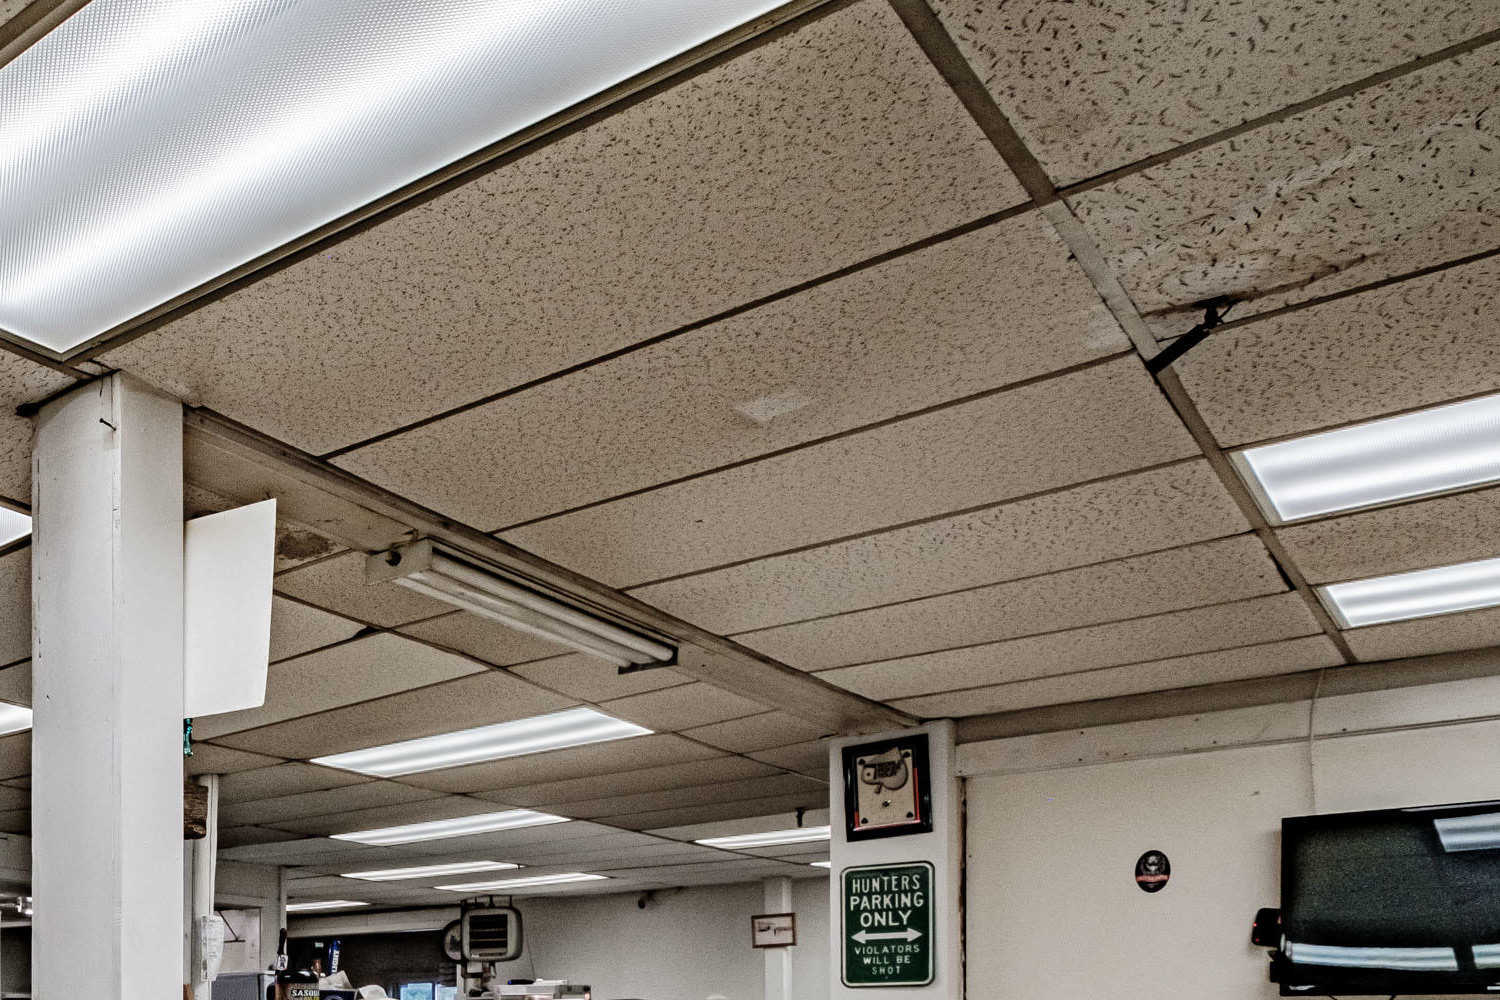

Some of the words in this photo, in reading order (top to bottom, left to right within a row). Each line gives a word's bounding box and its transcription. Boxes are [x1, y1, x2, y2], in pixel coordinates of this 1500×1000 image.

[852, 874, 921, 894] HUNTERS
[850, 892, 924, 911] PARKING
[860, 910, 912, 927] ONLY
[854, 944, 920, 955] VIOLATORS
[863, 956, 890, 965] WILL
[896, 955, 911, 964] BE
[871, 965, 901, 975] SHOT
